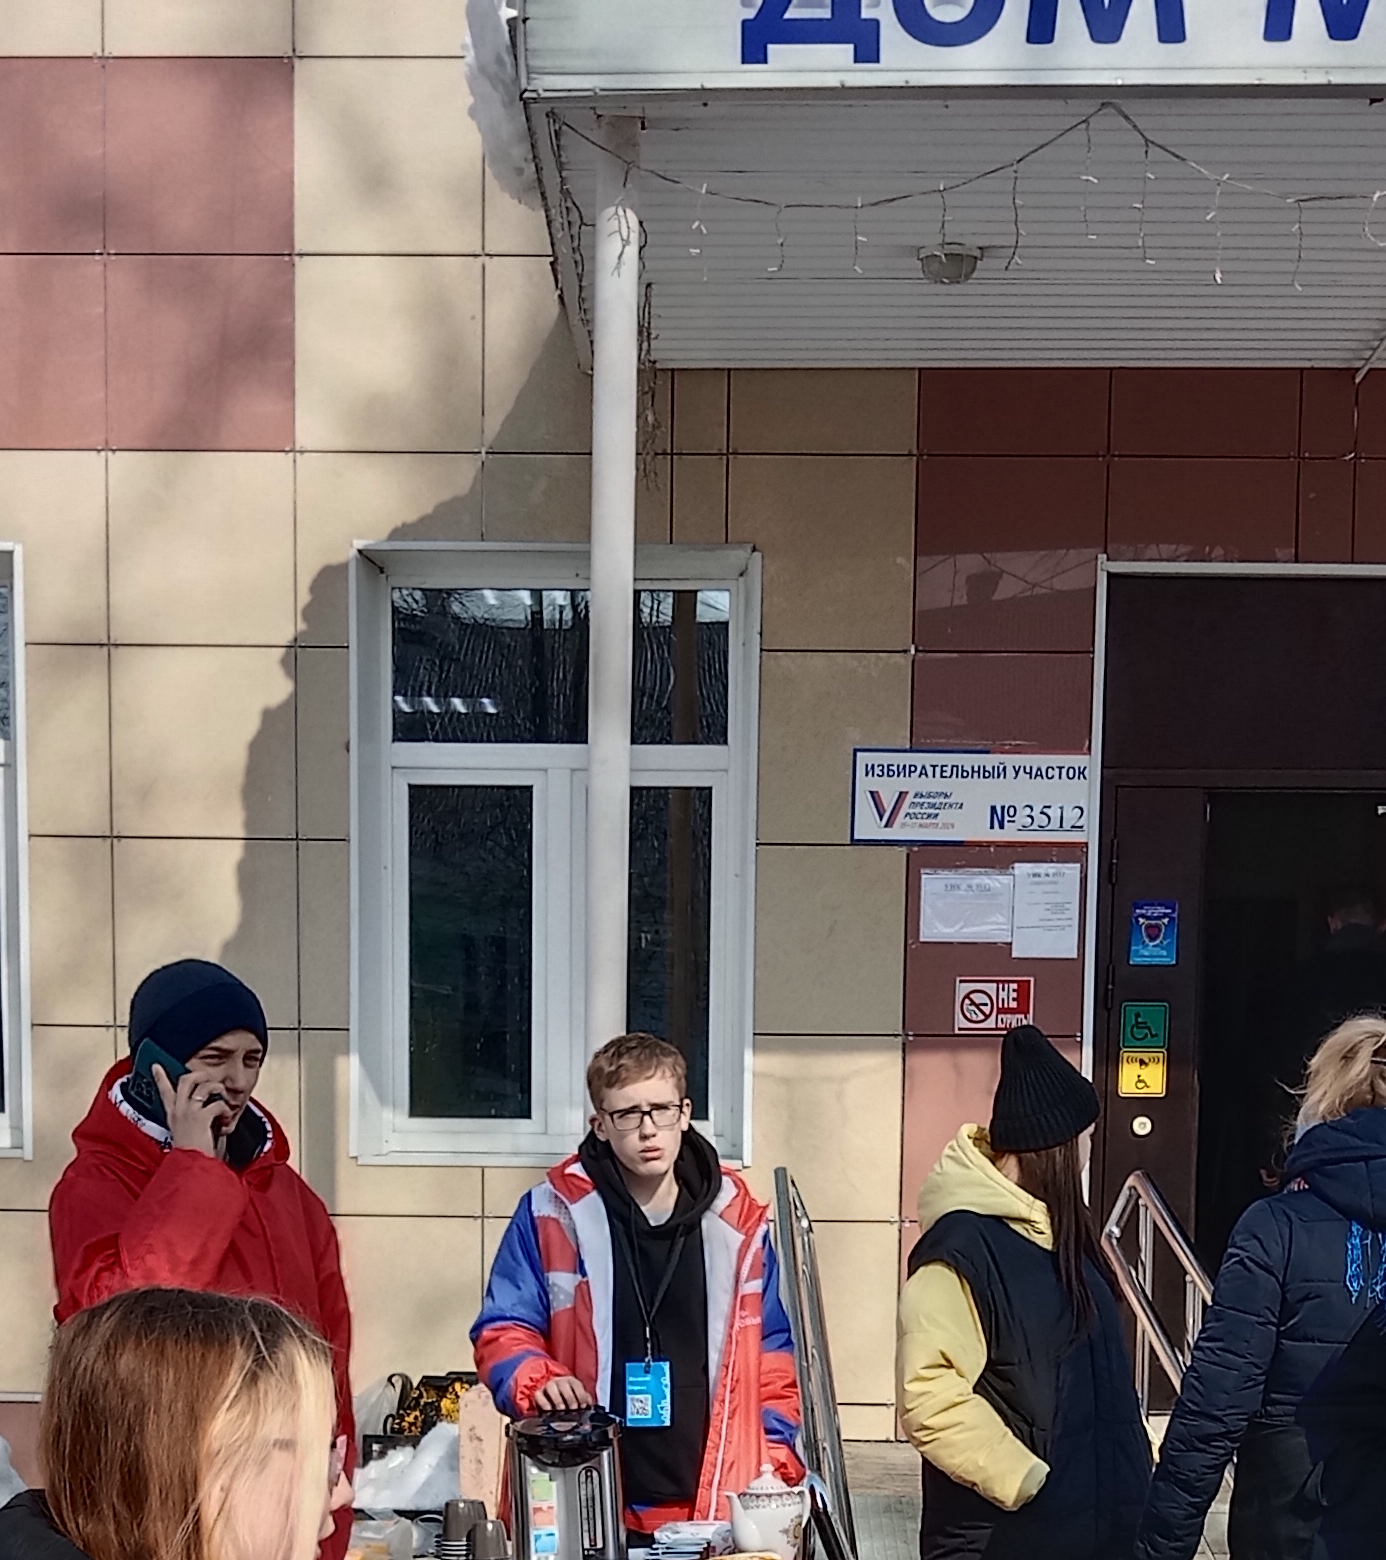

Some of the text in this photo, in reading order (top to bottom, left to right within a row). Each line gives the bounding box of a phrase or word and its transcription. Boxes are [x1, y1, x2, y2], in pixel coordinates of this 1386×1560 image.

[864, 762, 1088, 781] ИЗБИРАТЕЛЬНЫЙ УЧАСТОК
[912, 791, 953, 800] ВЫБОРЫ
[908, 801, 964, 811] ПРЕЗИДЕНТА
[903, 812, 939, 820] РОССИИ
[998, 982, 1018, 1009] НЕ
